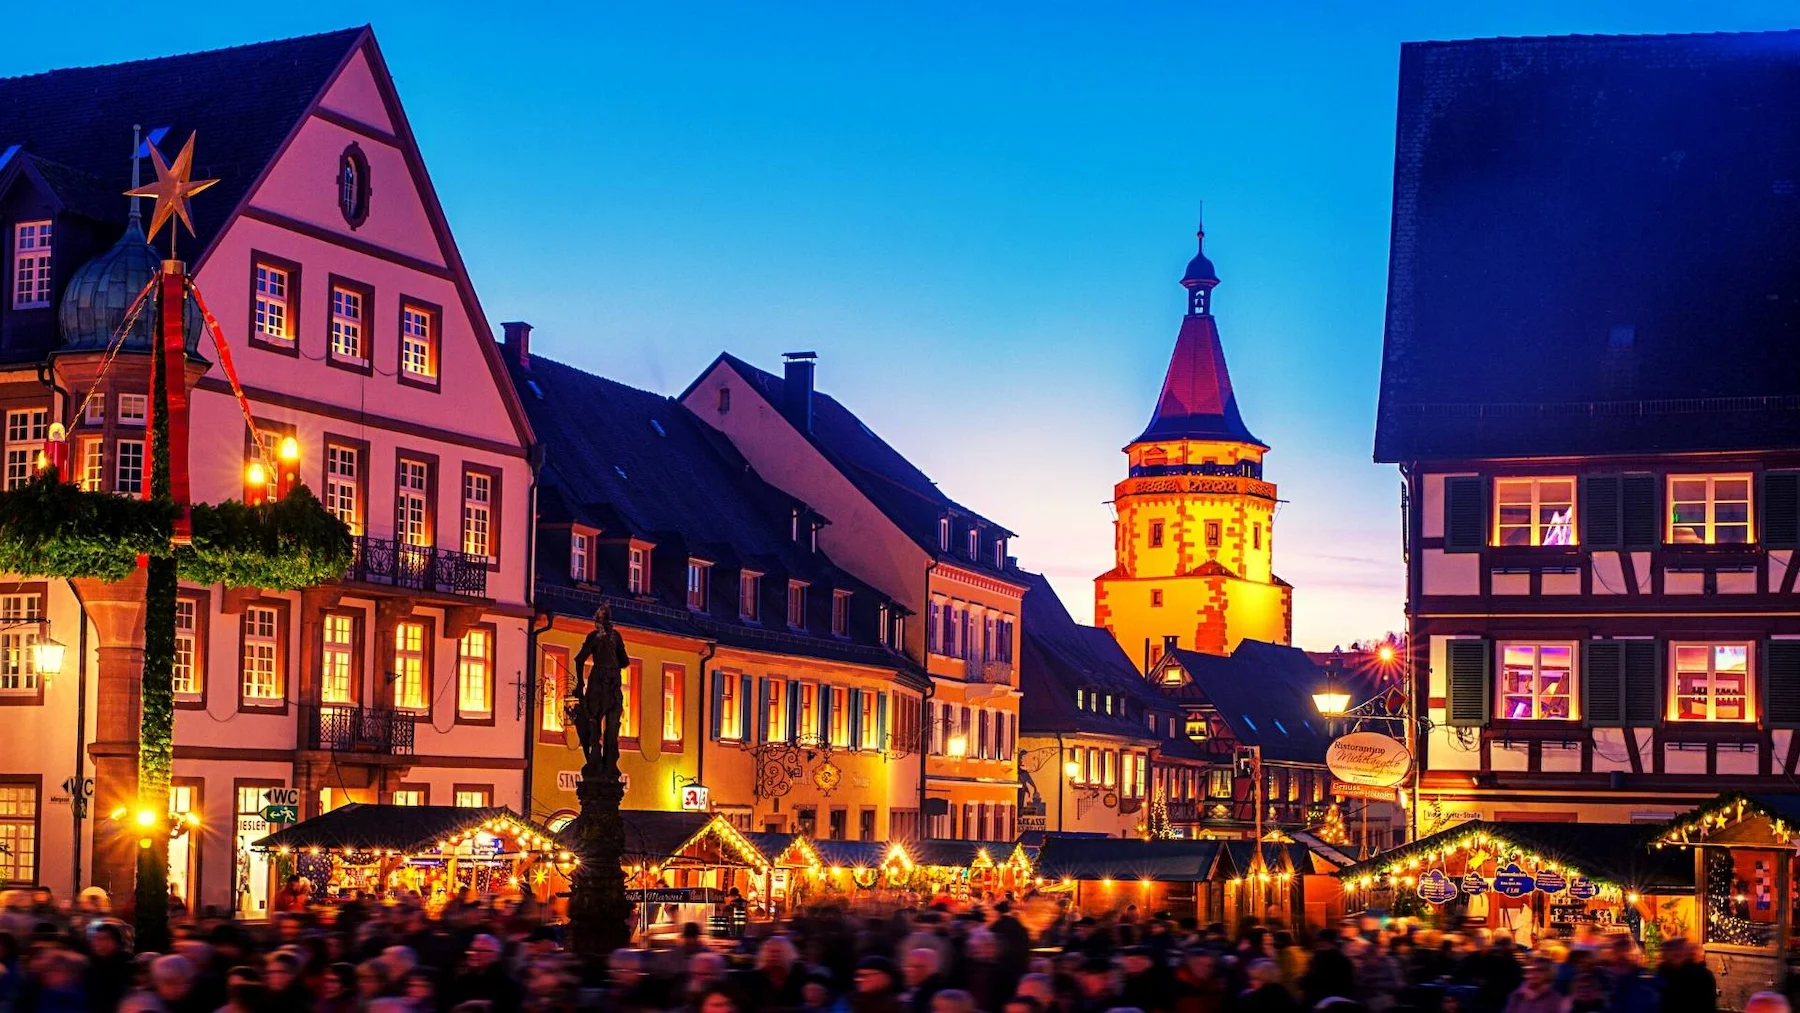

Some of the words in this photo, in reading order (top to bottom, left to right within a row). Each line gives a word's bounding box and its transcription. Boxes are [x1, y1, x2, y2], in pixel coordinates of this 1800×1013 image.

[1334, 741, 1386, 755] Ristorantino
[1335, 749, 1407, 774] Michelangelo
[1332, 783, 1360, 791] Genuss
[273, 789, 298, 805] WC
[239, 820, 266, 831] IESLER
[646, 891, 684, 901] Maroni
